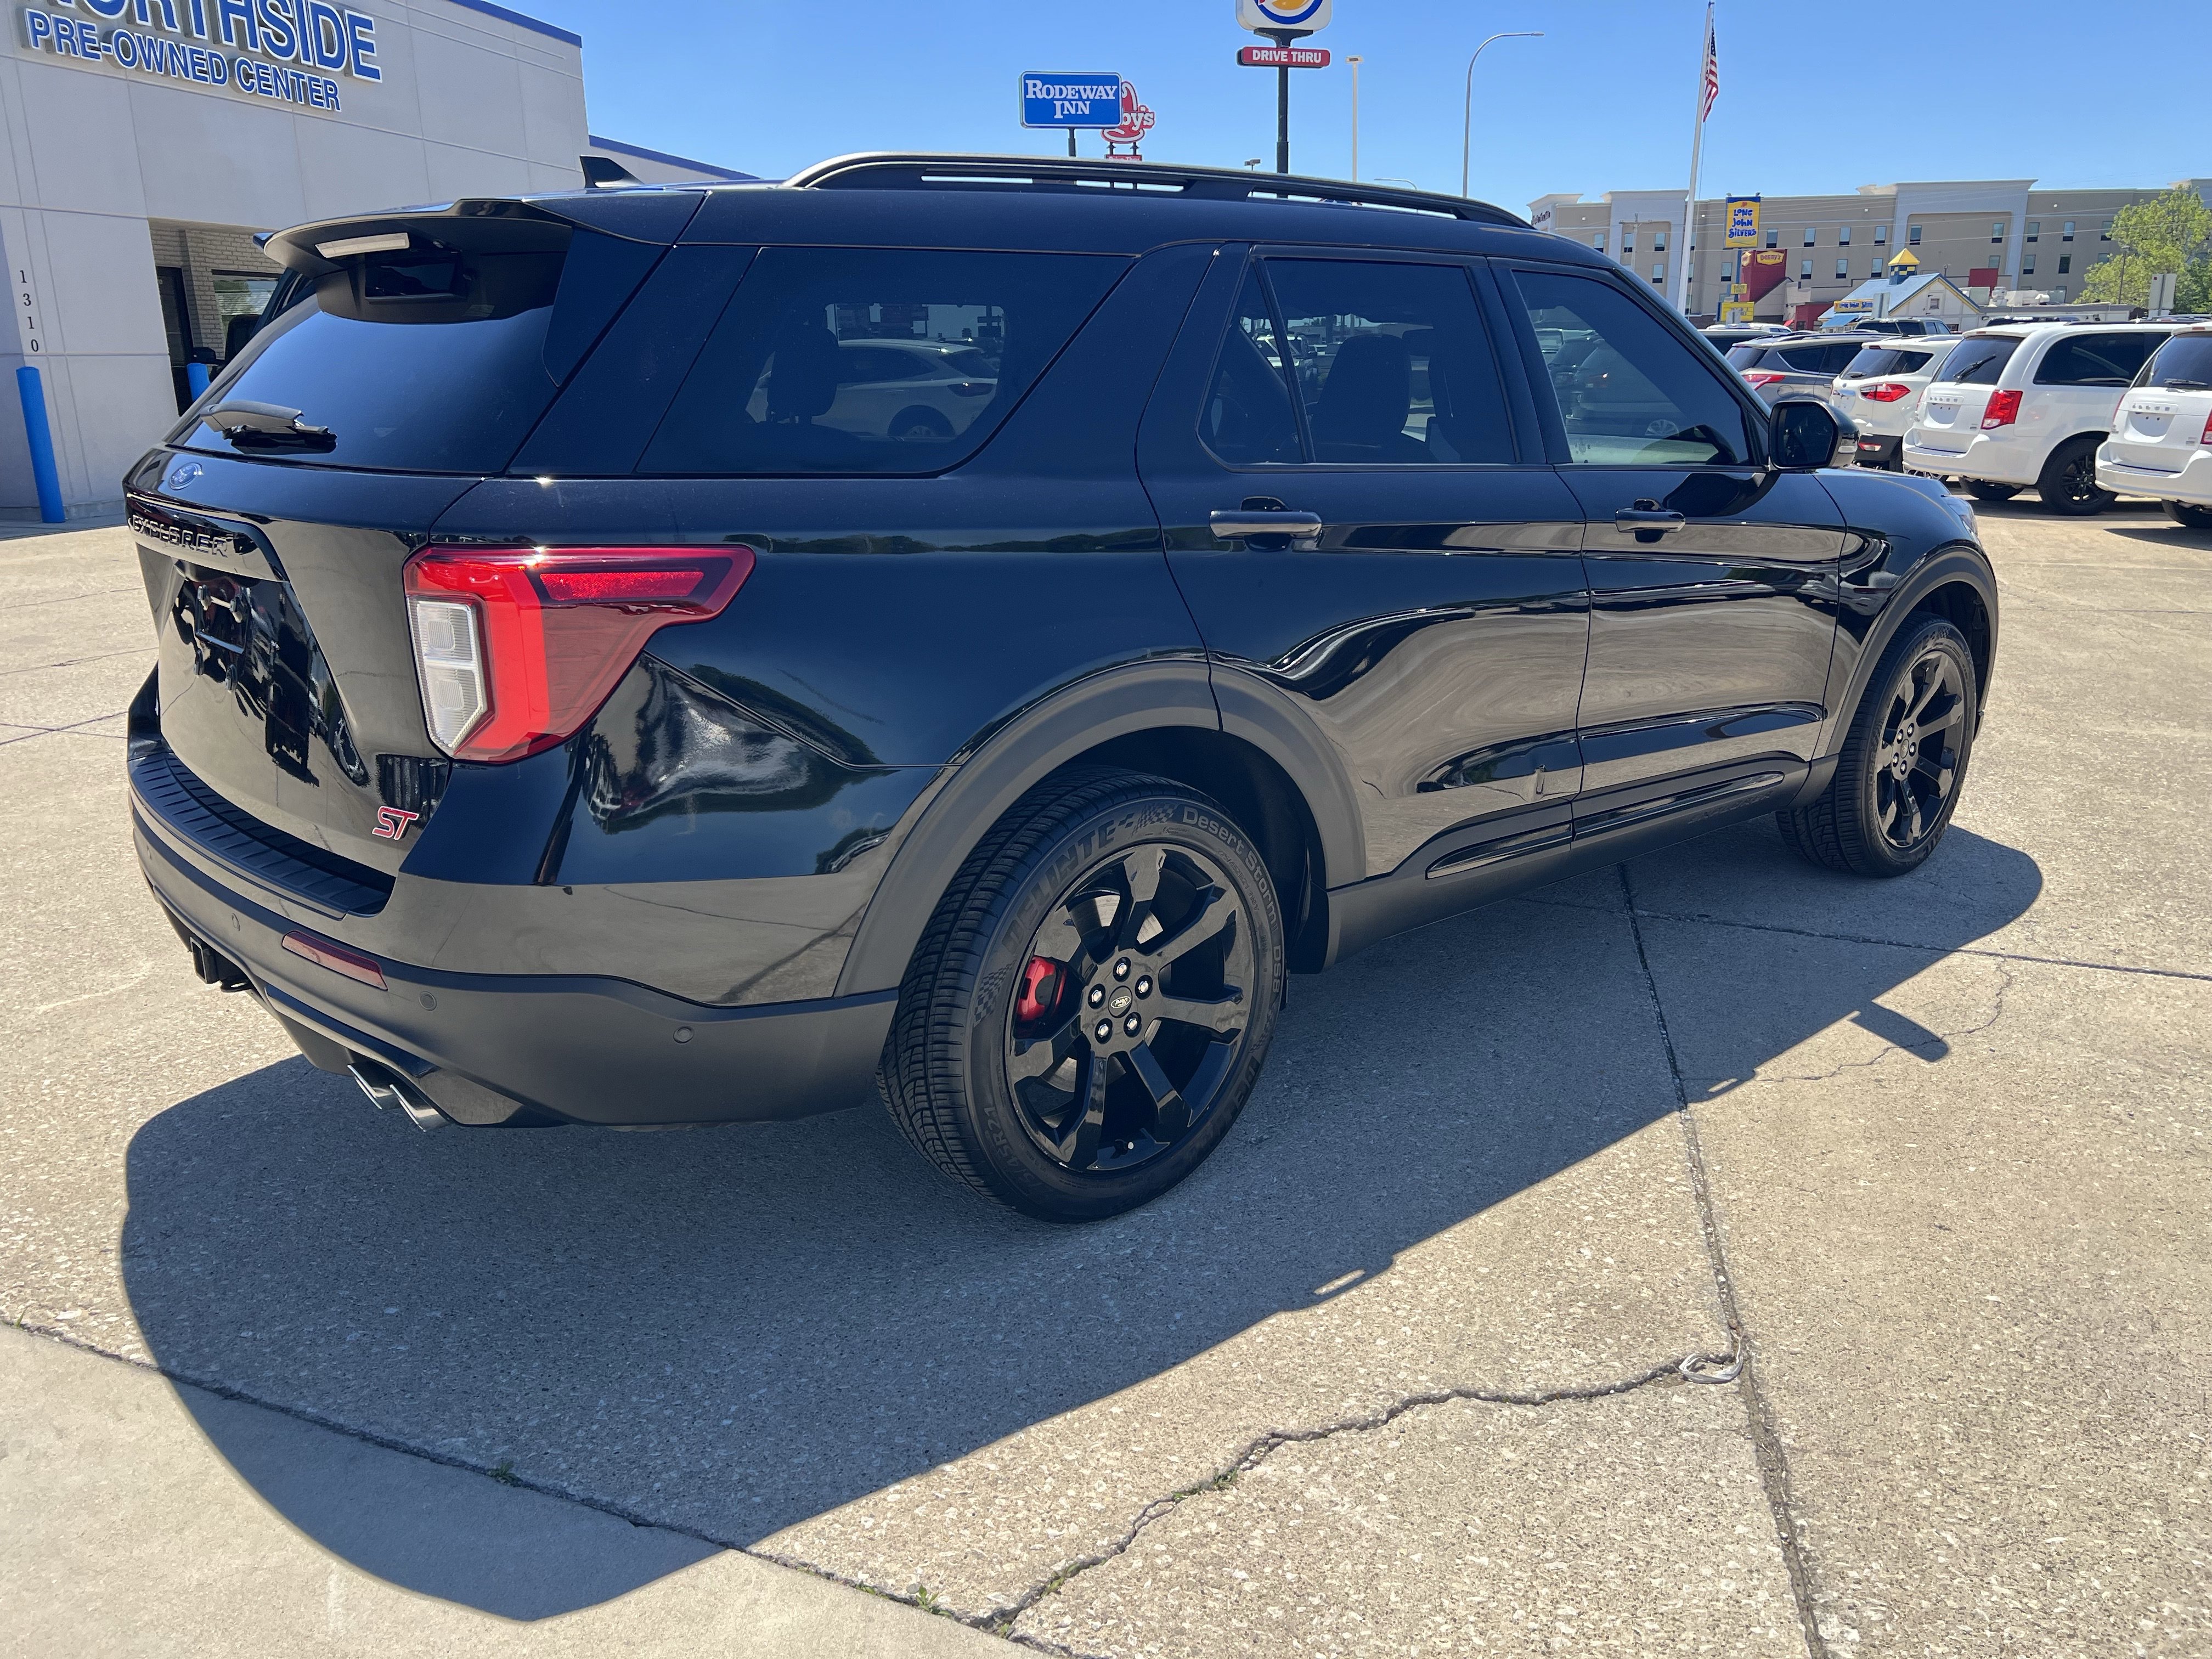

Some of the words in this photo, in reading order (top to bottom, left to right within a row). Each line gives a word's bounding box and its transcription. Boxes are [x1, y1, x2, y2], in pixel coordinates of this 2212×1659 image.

[58, 0, 382, 83] HSIDE
[1252, 49, 1288, 61] DRIVE
[1291, 52, 1322, 63] THRU
[25, 8, 229, 87] PRE-OWNED
[235, 57, 342, 112] CENTER
[1025, 80, 1118, 99] RODEWAY
[1053, 100, 1091, 119] INN
[372, 806, 419, 840] ST
[1182, 805, 1245, 855] Desert
[1272, 945, 1282, 994] DS8
